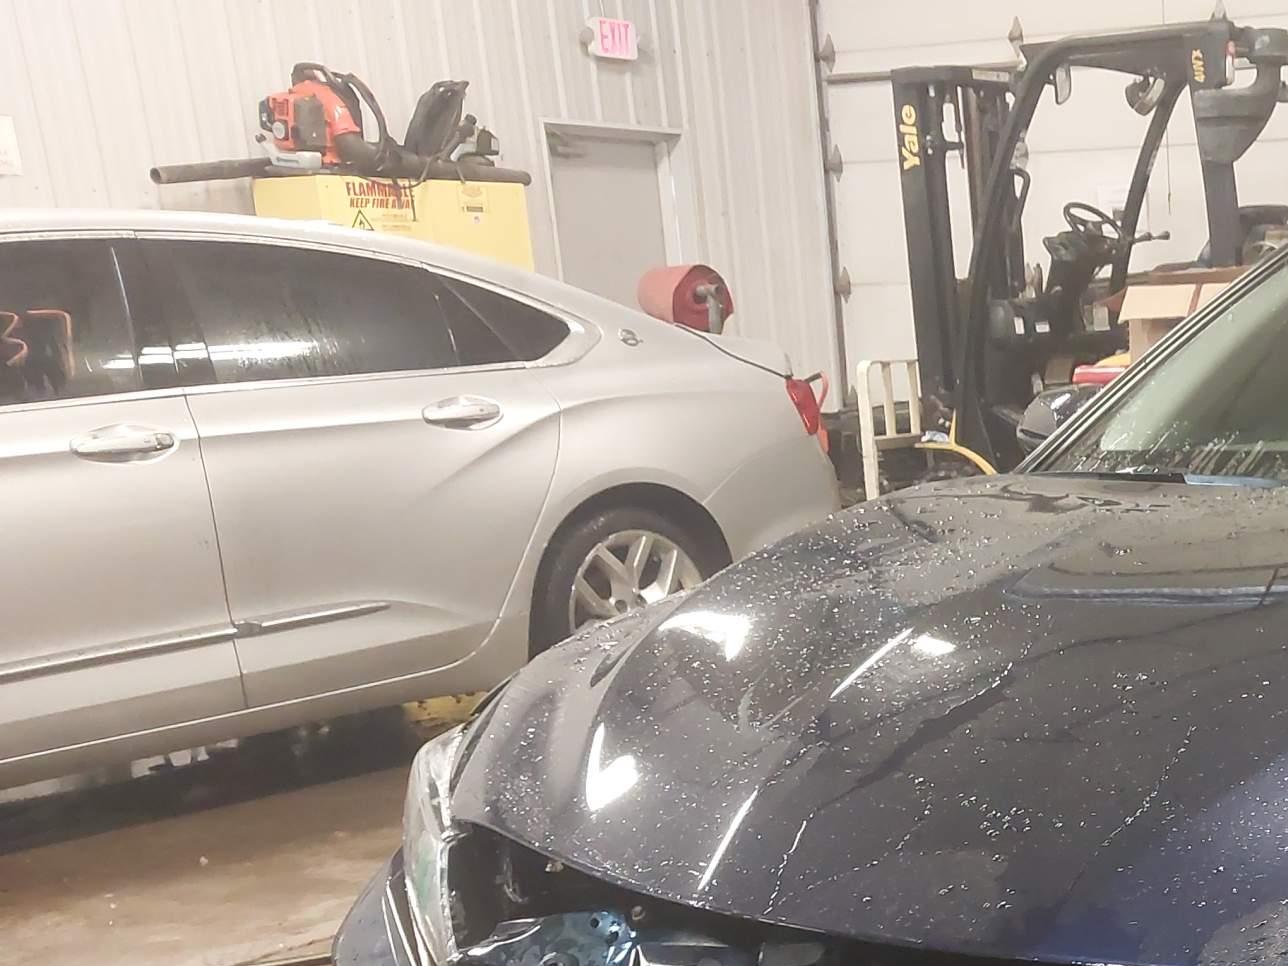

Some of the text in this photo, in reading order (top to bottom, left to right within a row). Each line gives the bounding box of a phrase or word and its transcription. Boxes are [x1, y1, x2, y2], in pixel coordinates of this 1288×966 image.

[599, 19, 630, 55] EXIT
[899, 104, 920, 170] Yale
[345, 181, 415, 198] FLAMMALE
[350, 197, 413, 210] KEEP FIRE AA
